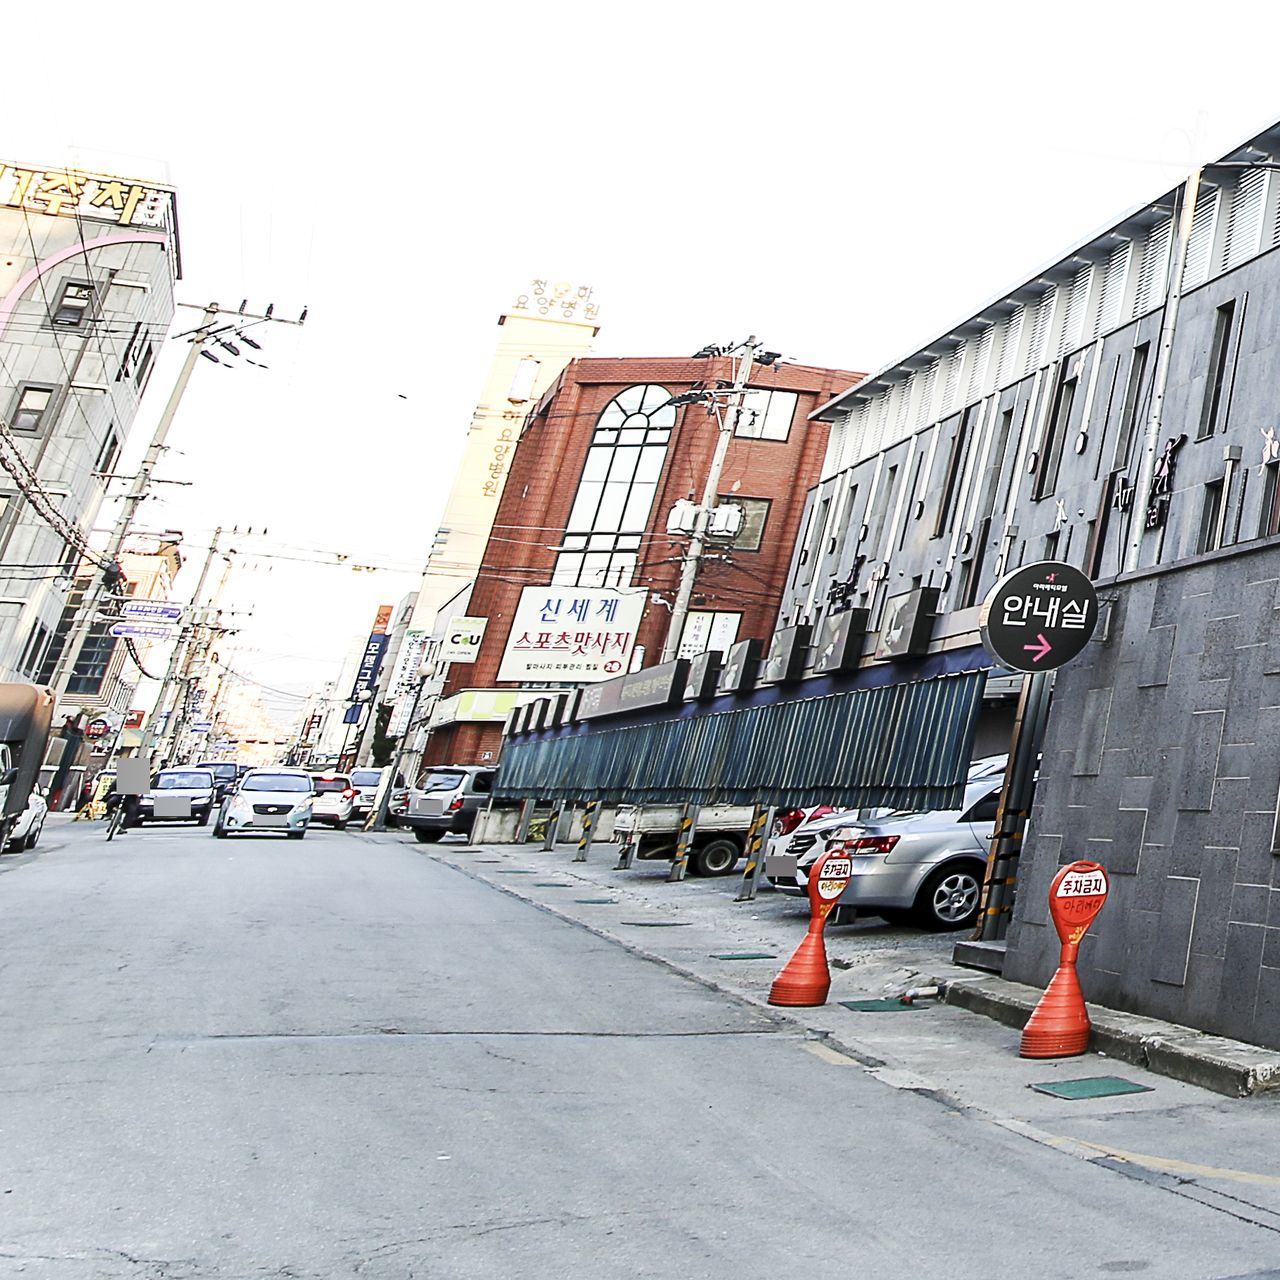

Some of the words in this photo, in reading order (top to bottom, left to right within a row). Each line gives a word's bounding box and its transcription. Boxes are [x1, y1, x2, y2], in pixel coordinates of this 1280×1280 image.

[540, 599, 618, 622] 신세계
[1002, 595, 1089, 629] 안내실
[451, 634, 481, 645] CU
[513, 632, 630, 655] 스포츠맛사지
[823, 863, 849, 876] 주차금지
